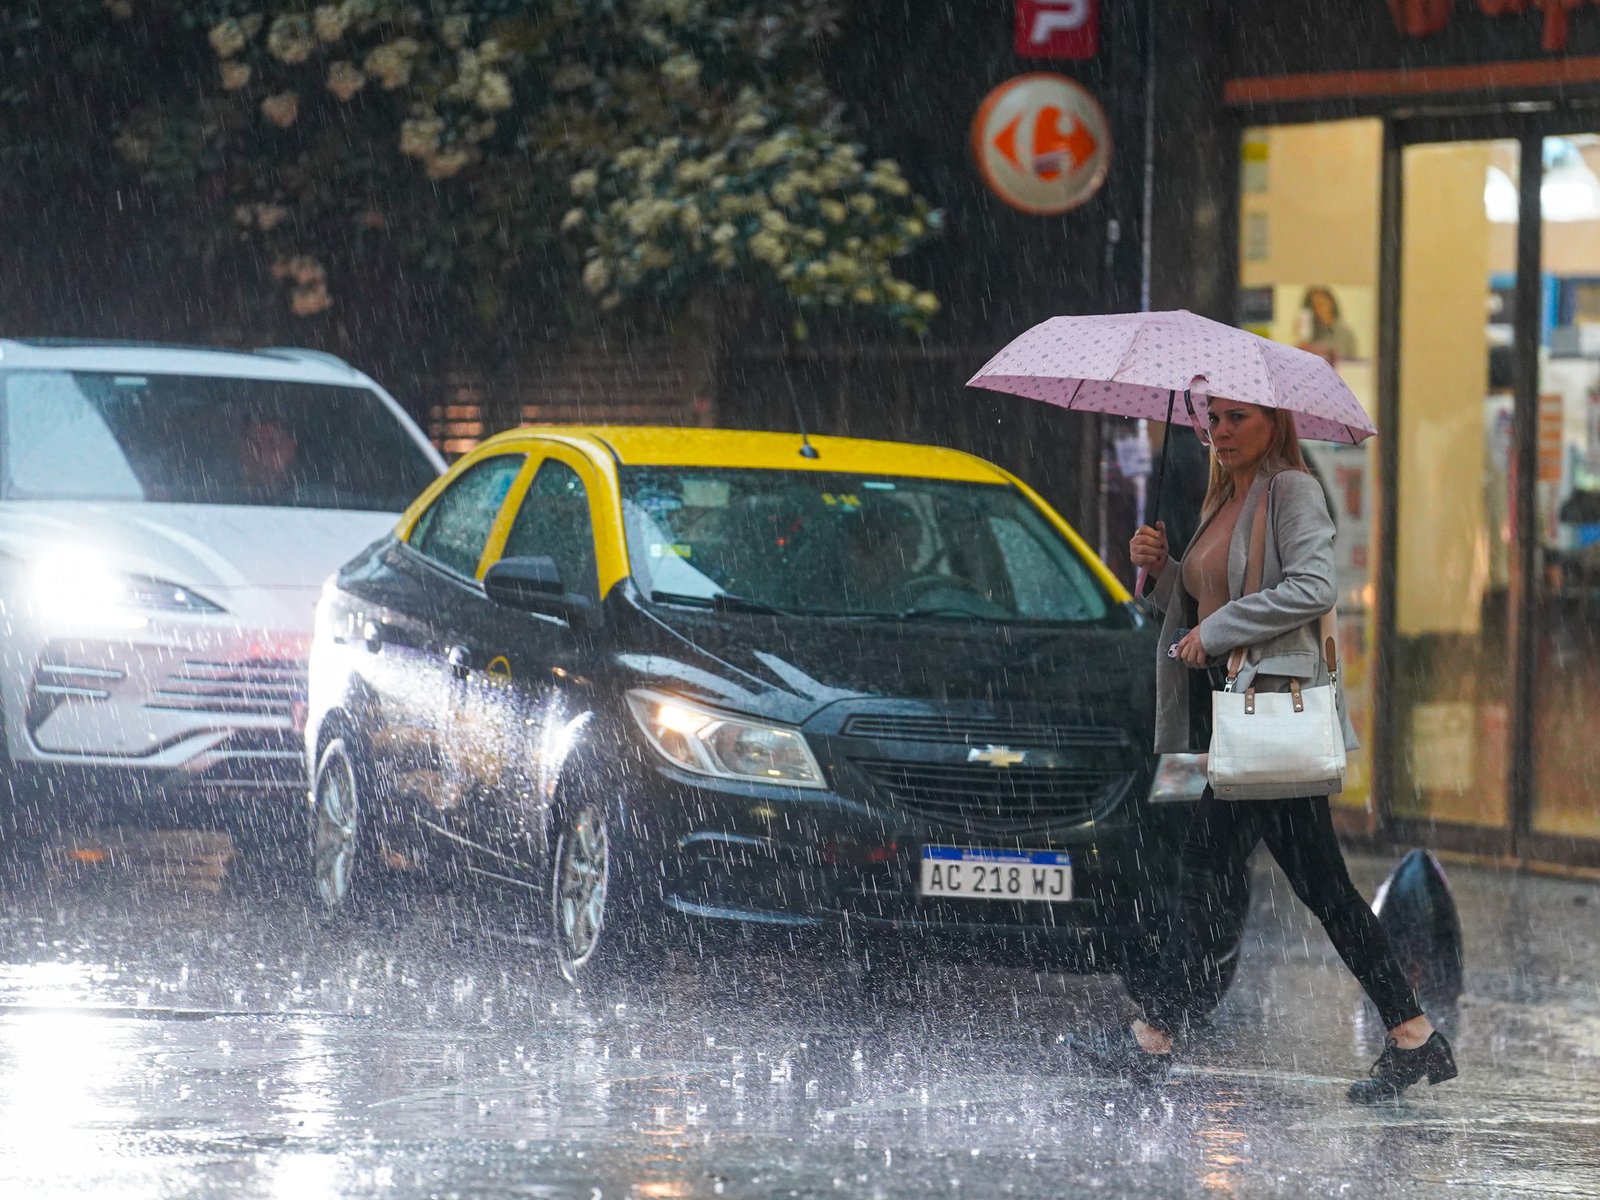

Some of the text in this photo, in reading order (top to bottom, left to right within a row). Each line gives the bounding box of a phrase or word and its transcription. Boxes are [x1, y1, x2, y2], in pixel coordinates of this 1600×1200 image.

[930, 864, 1063, 895] AC 218 WJ
